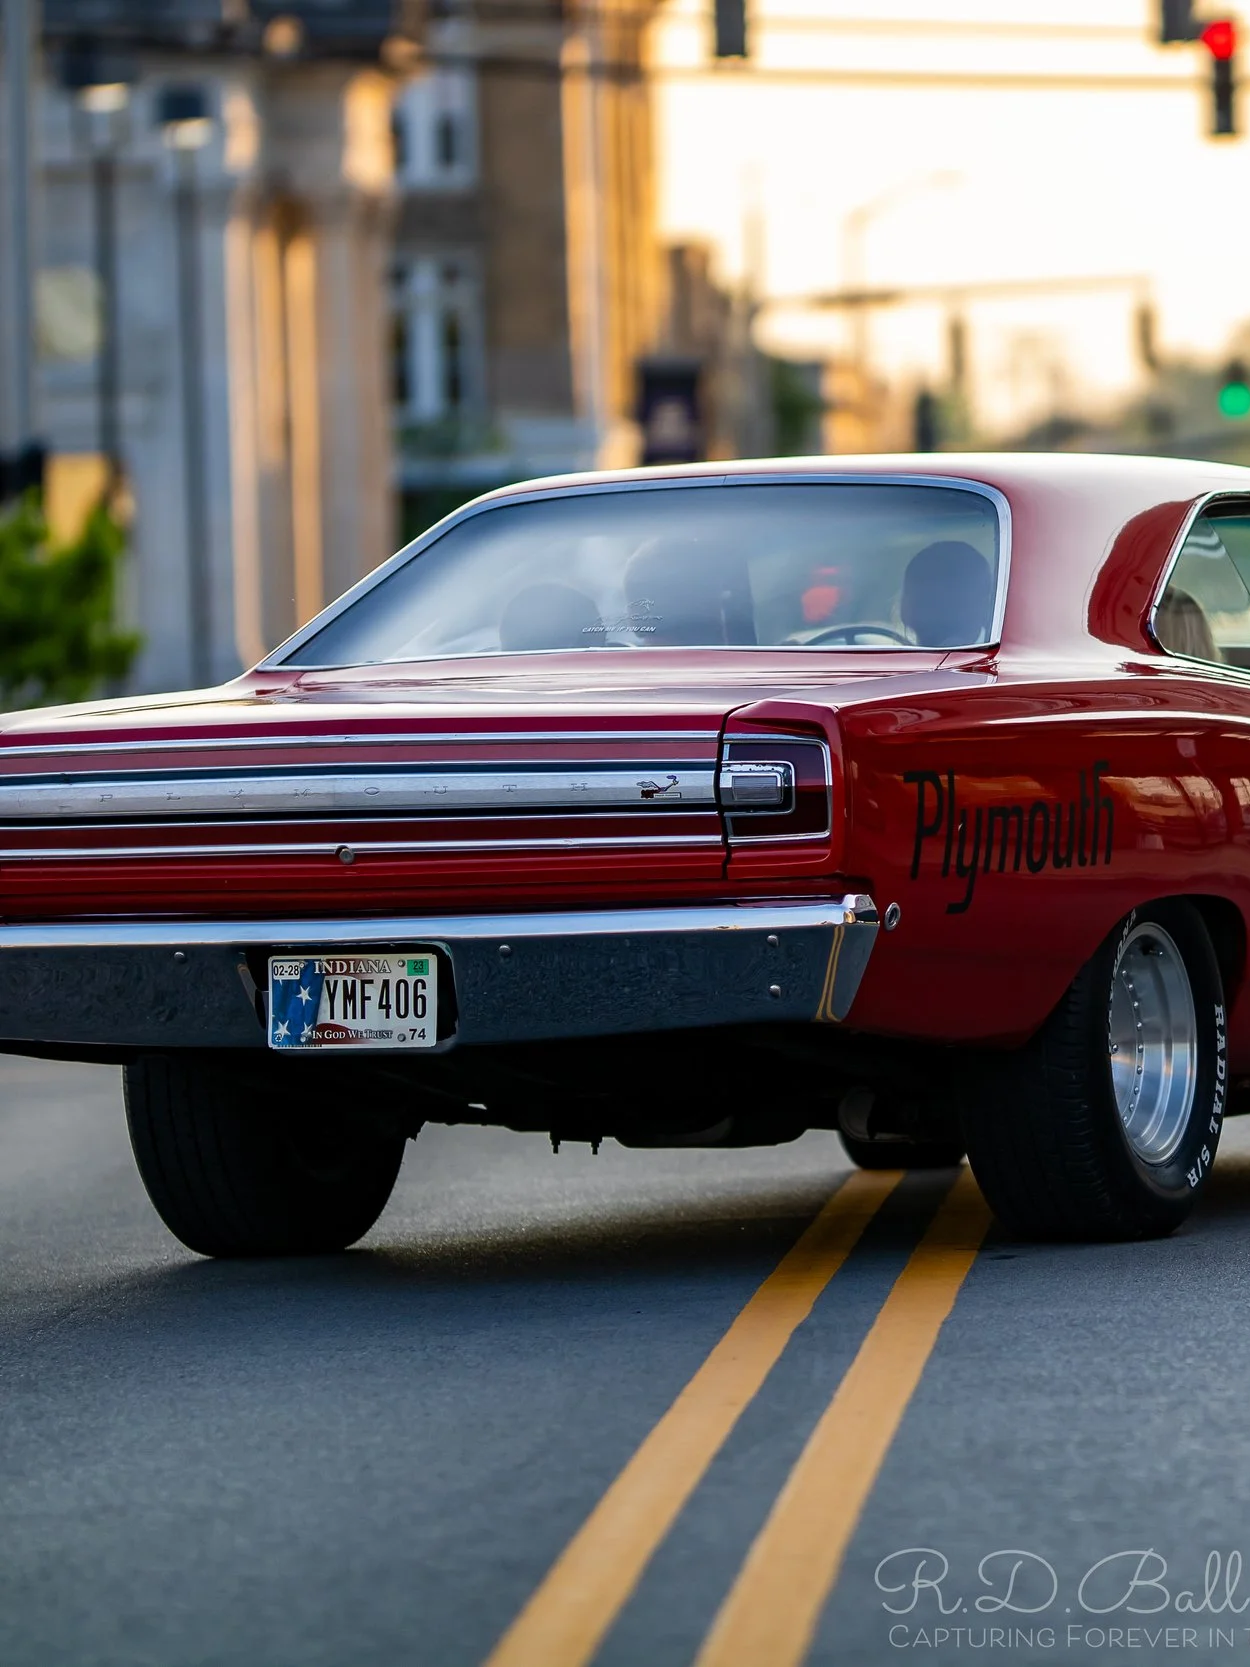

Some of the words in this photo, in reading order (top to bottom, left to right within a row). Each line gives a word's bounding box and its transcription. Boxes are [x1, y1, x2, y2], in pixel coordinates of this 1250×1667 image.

[903, 759, 1115, 915] Plymouth
[273, 965, 299, 976] 02-28
[313, 960, 391, 974] INDIANA
[413, 961, 424, 970] 23
[325, 978, 427, 1020] YMF406
[312, 1030, 322, 1039] IN
[363, 1028, 393, 1039] TRUST
[409, 1028, 426, 1040] 74
[1209, 1003, 1227, 1134] RADIAL
